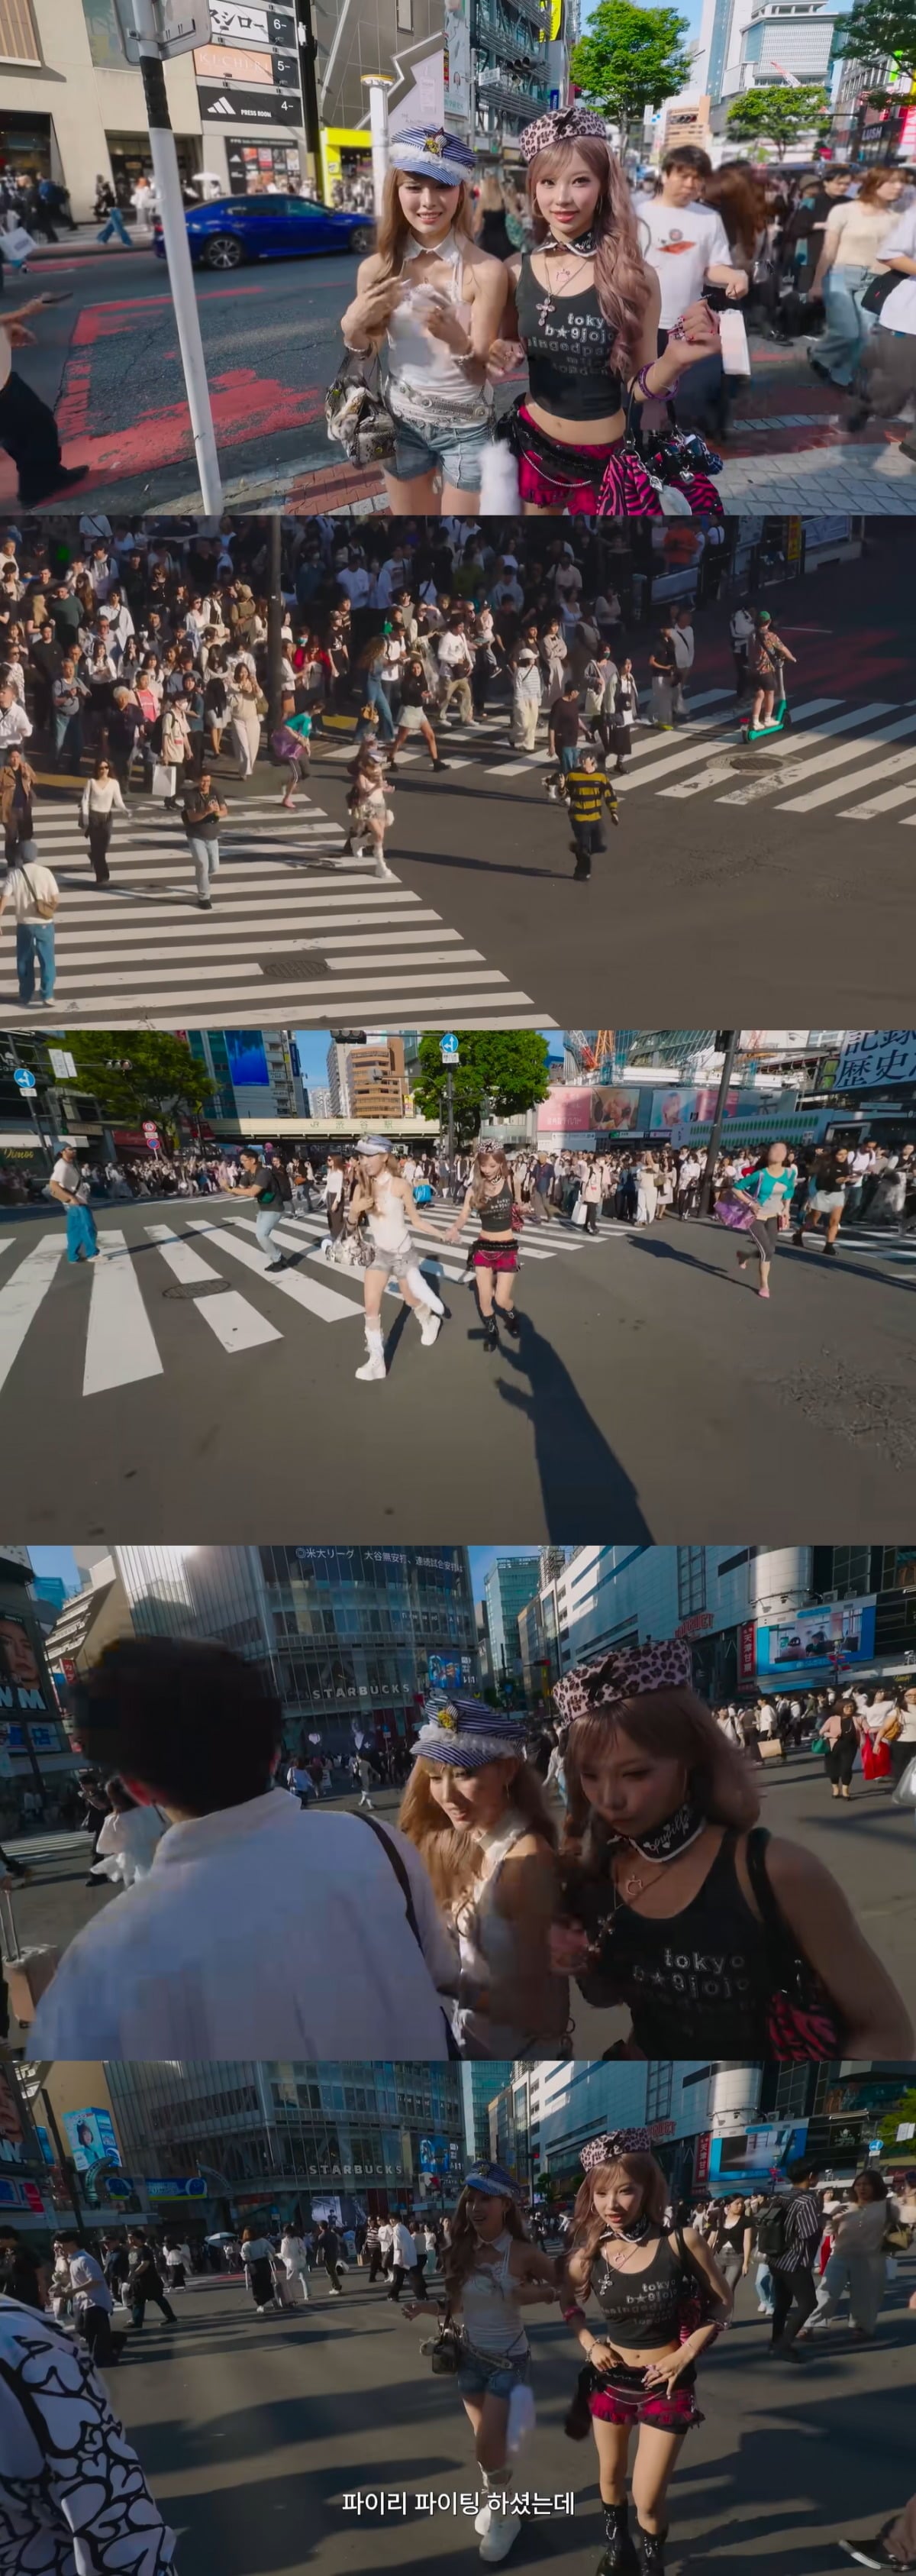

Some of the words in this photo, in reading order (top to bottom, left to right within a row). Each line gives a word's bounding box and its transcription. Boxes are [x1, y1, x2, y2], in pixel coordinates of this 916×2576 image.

[862, 126, 883, 141] LUSH
[568, 312, 605, 328] toky
[835, 1049, 916, 1088] 歴史
[313, 1683, 410, 1699] STARBUCKS
[664, 1947, 745, 1976] tokyo
[308, 2164, 402, 2175] STARBUCKS
[642, 2280, 676, 2292] tokyo
